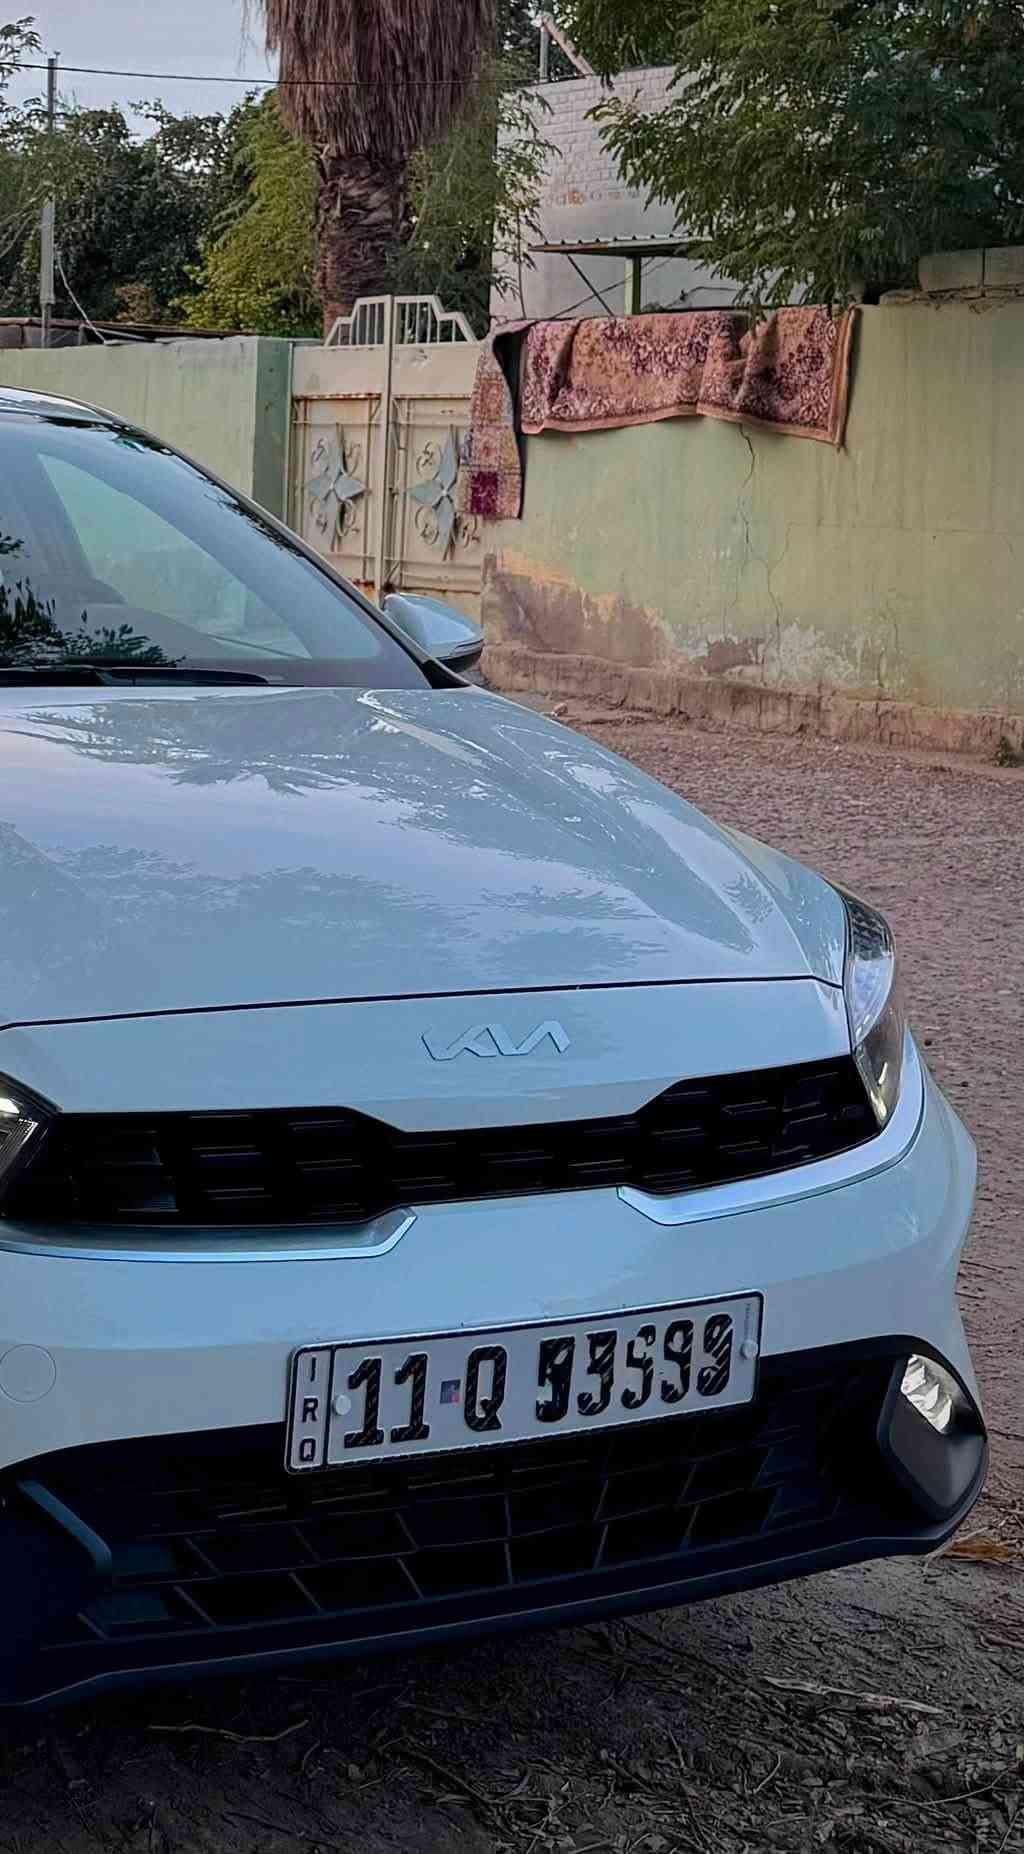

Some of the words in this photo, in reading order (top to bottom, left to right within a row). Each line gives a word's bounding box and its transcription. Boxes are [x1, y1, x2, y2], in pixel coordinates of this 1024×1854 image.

[420, 1020, 571, 1062] KIA
[298, 1355, 320, 1463] IRQ
[463, 1344, 508, 1432] Q
